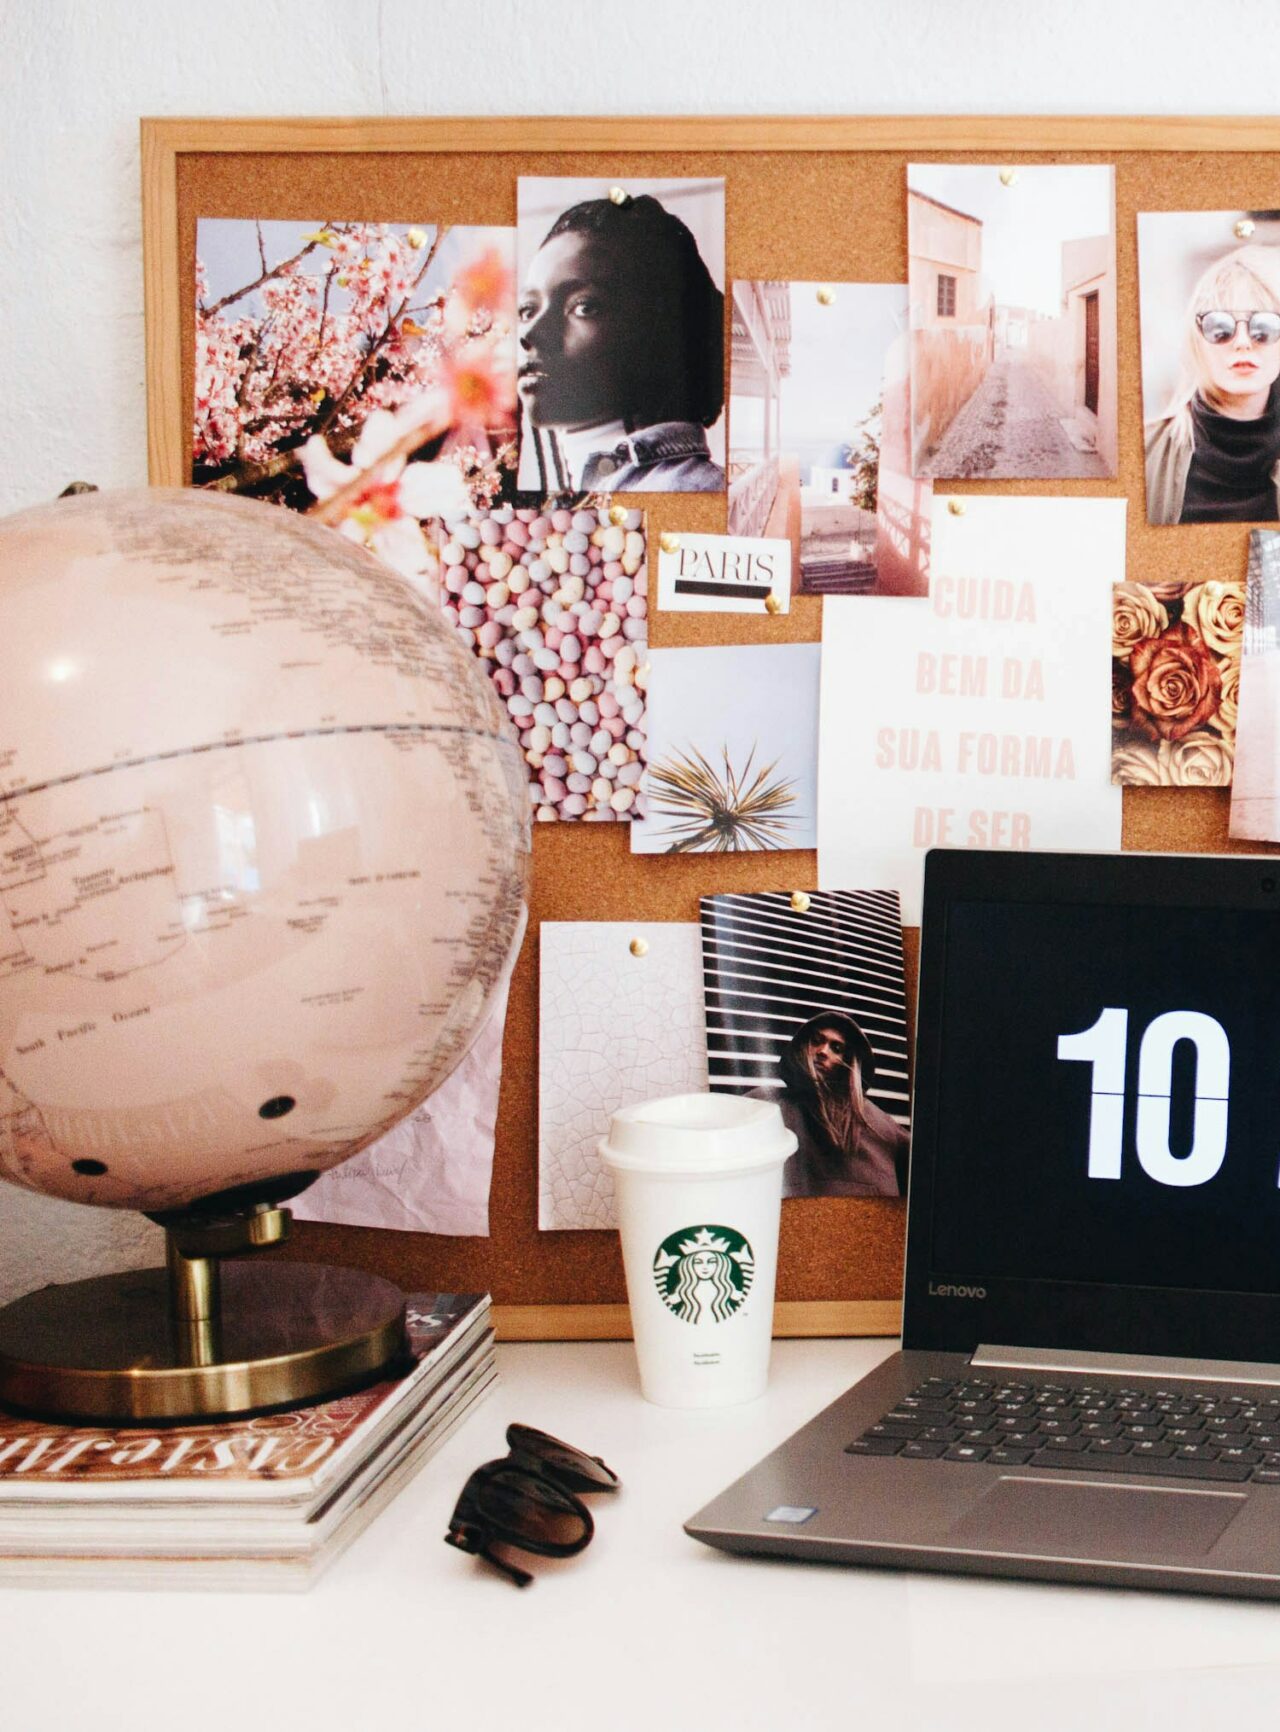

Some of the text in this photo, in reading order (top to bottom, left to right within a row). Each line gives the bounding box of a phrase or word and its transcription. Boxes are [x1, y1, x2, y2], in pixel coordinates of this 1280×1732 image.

[677, 548, 774, 582] PARIS
[933, 576, 1037, 624] CUIDA
[916, 651, 1046, 701] BEM DA
[875, 727, 1077, 780] SUA FORMA
[912, 806, 1032, 850] DE SER
[1057, 1007, 1231, 1187] 10
[928, 1281, 988, 1299] Lenovo
